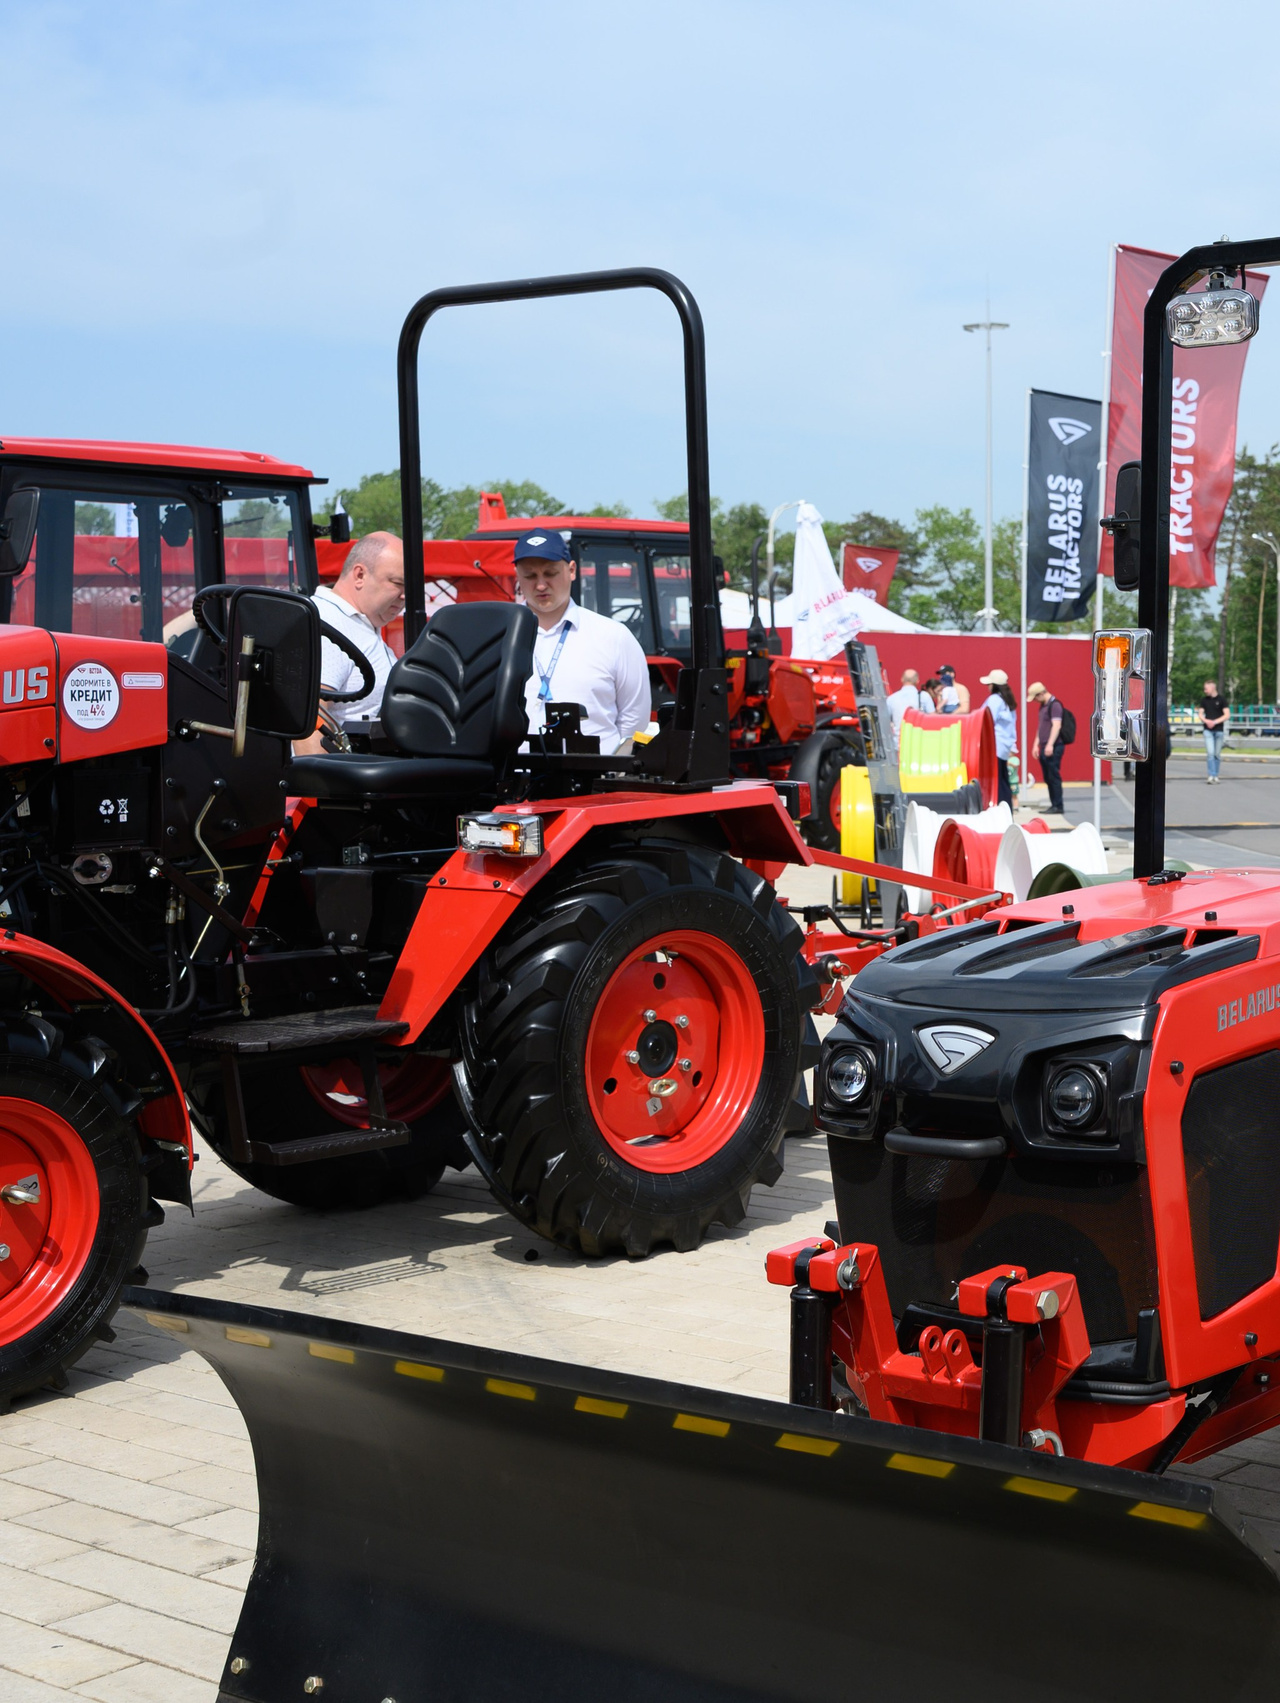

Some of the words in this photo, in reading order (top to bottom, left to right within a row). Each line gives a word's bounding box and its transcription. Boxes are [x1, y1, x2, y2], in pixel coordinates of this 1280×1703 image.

[1169, 376, 1200, 556] TRACTORS
[1042, 474, 1068, 603] BELARUS
[1060, 477, 1084, 603] TRACTORS
[70, 679, 106, 687] ОФОРМИТЕ
[107, 679, 112, 687] В
[70, 689, 112, 704] КРЕДИТ
[90, 704, 106, 717] 4%
